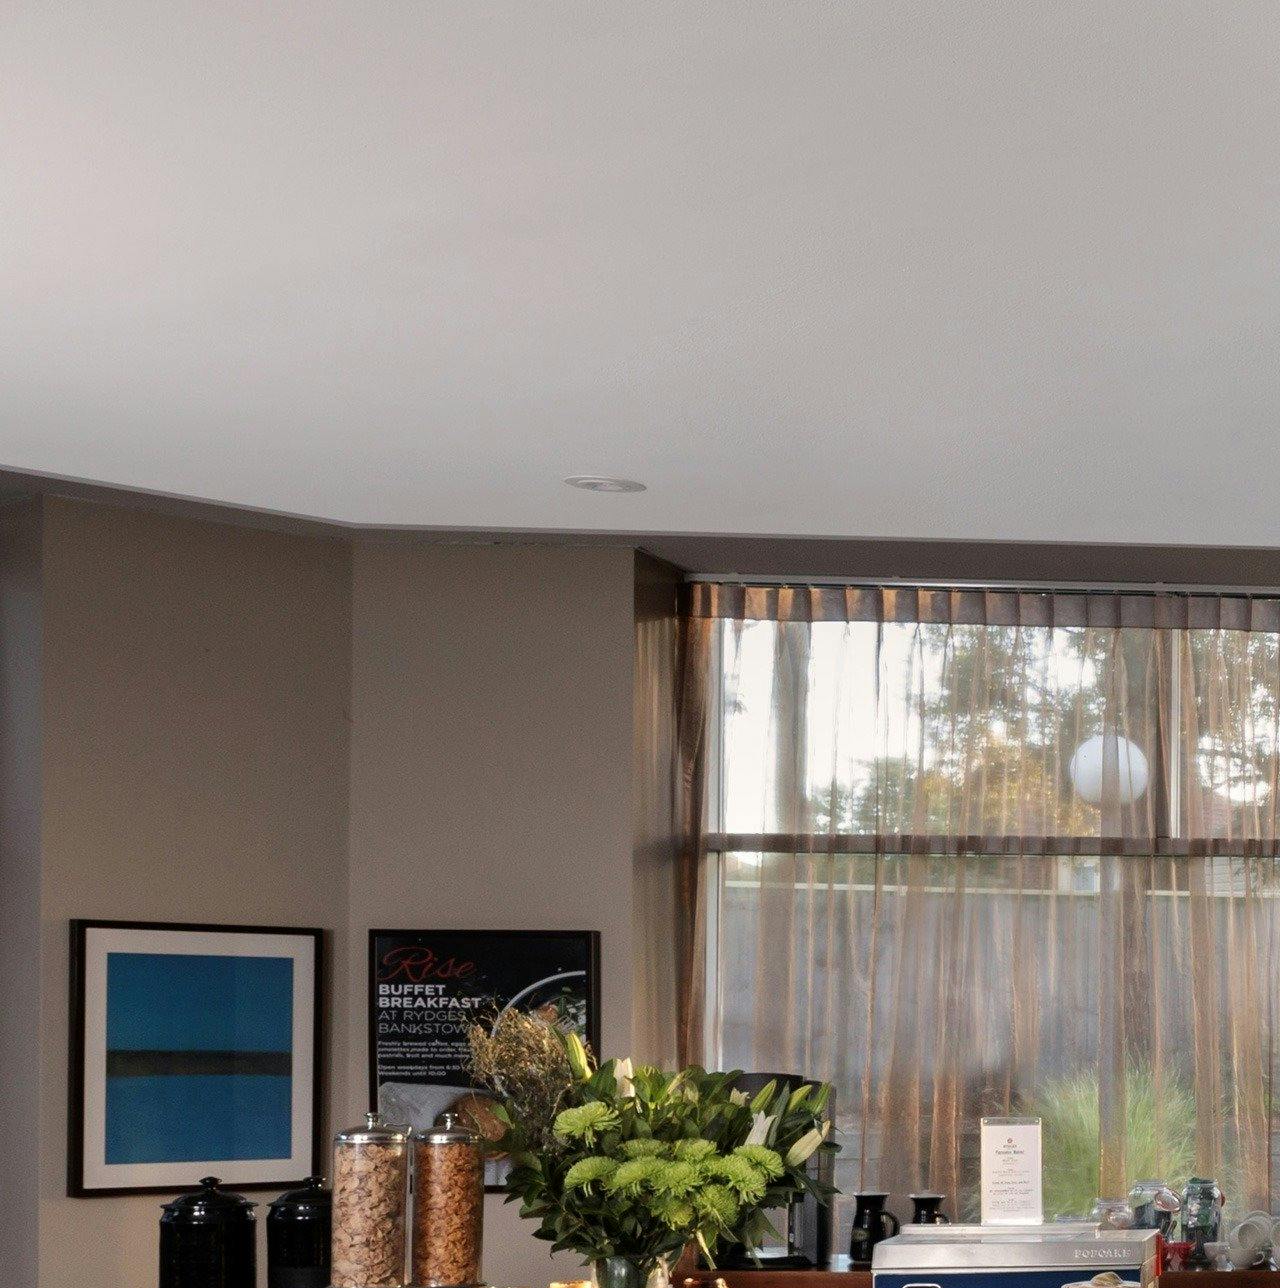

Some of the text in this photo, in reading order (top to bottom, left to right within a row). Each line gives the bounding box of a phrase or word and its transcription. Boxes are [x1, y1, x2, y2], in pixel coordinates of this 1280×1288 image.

[378, 946, 475, 982] Rise
[379, 984, 446, 996] BUFFET
[379, 997, 482, 1008] BREAKFAST
[378, 1010, 467, 1021] AT RYDGES
[379, 1022, 467, 1034] BANKSTOW
